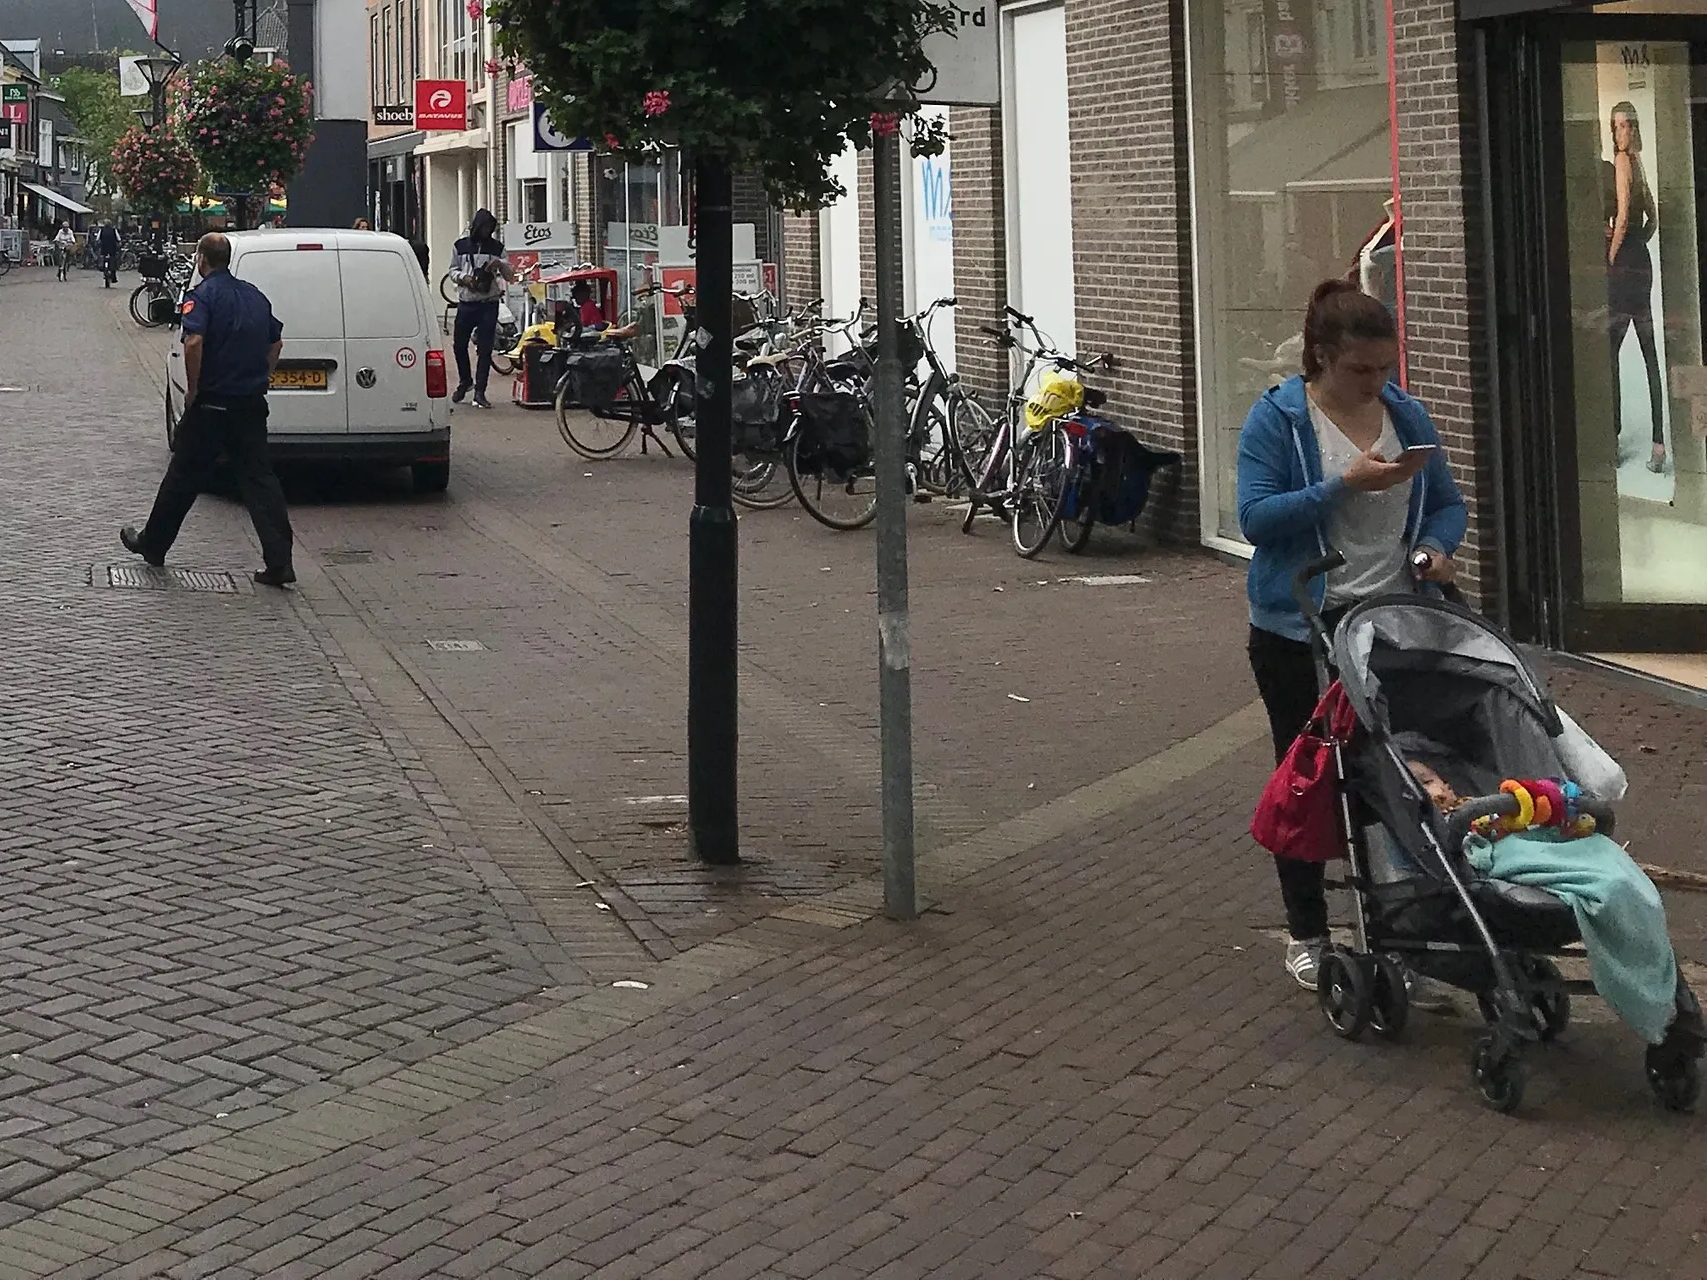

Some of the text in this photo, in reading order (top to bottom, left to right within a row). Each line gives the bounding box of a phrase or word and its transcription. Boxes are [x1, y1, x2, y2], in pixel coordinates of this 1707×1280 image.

[376, 107, 414, 121] shoeb
[524, 224, 552, 240] Etos
[399, 352, 413, 362] 110
